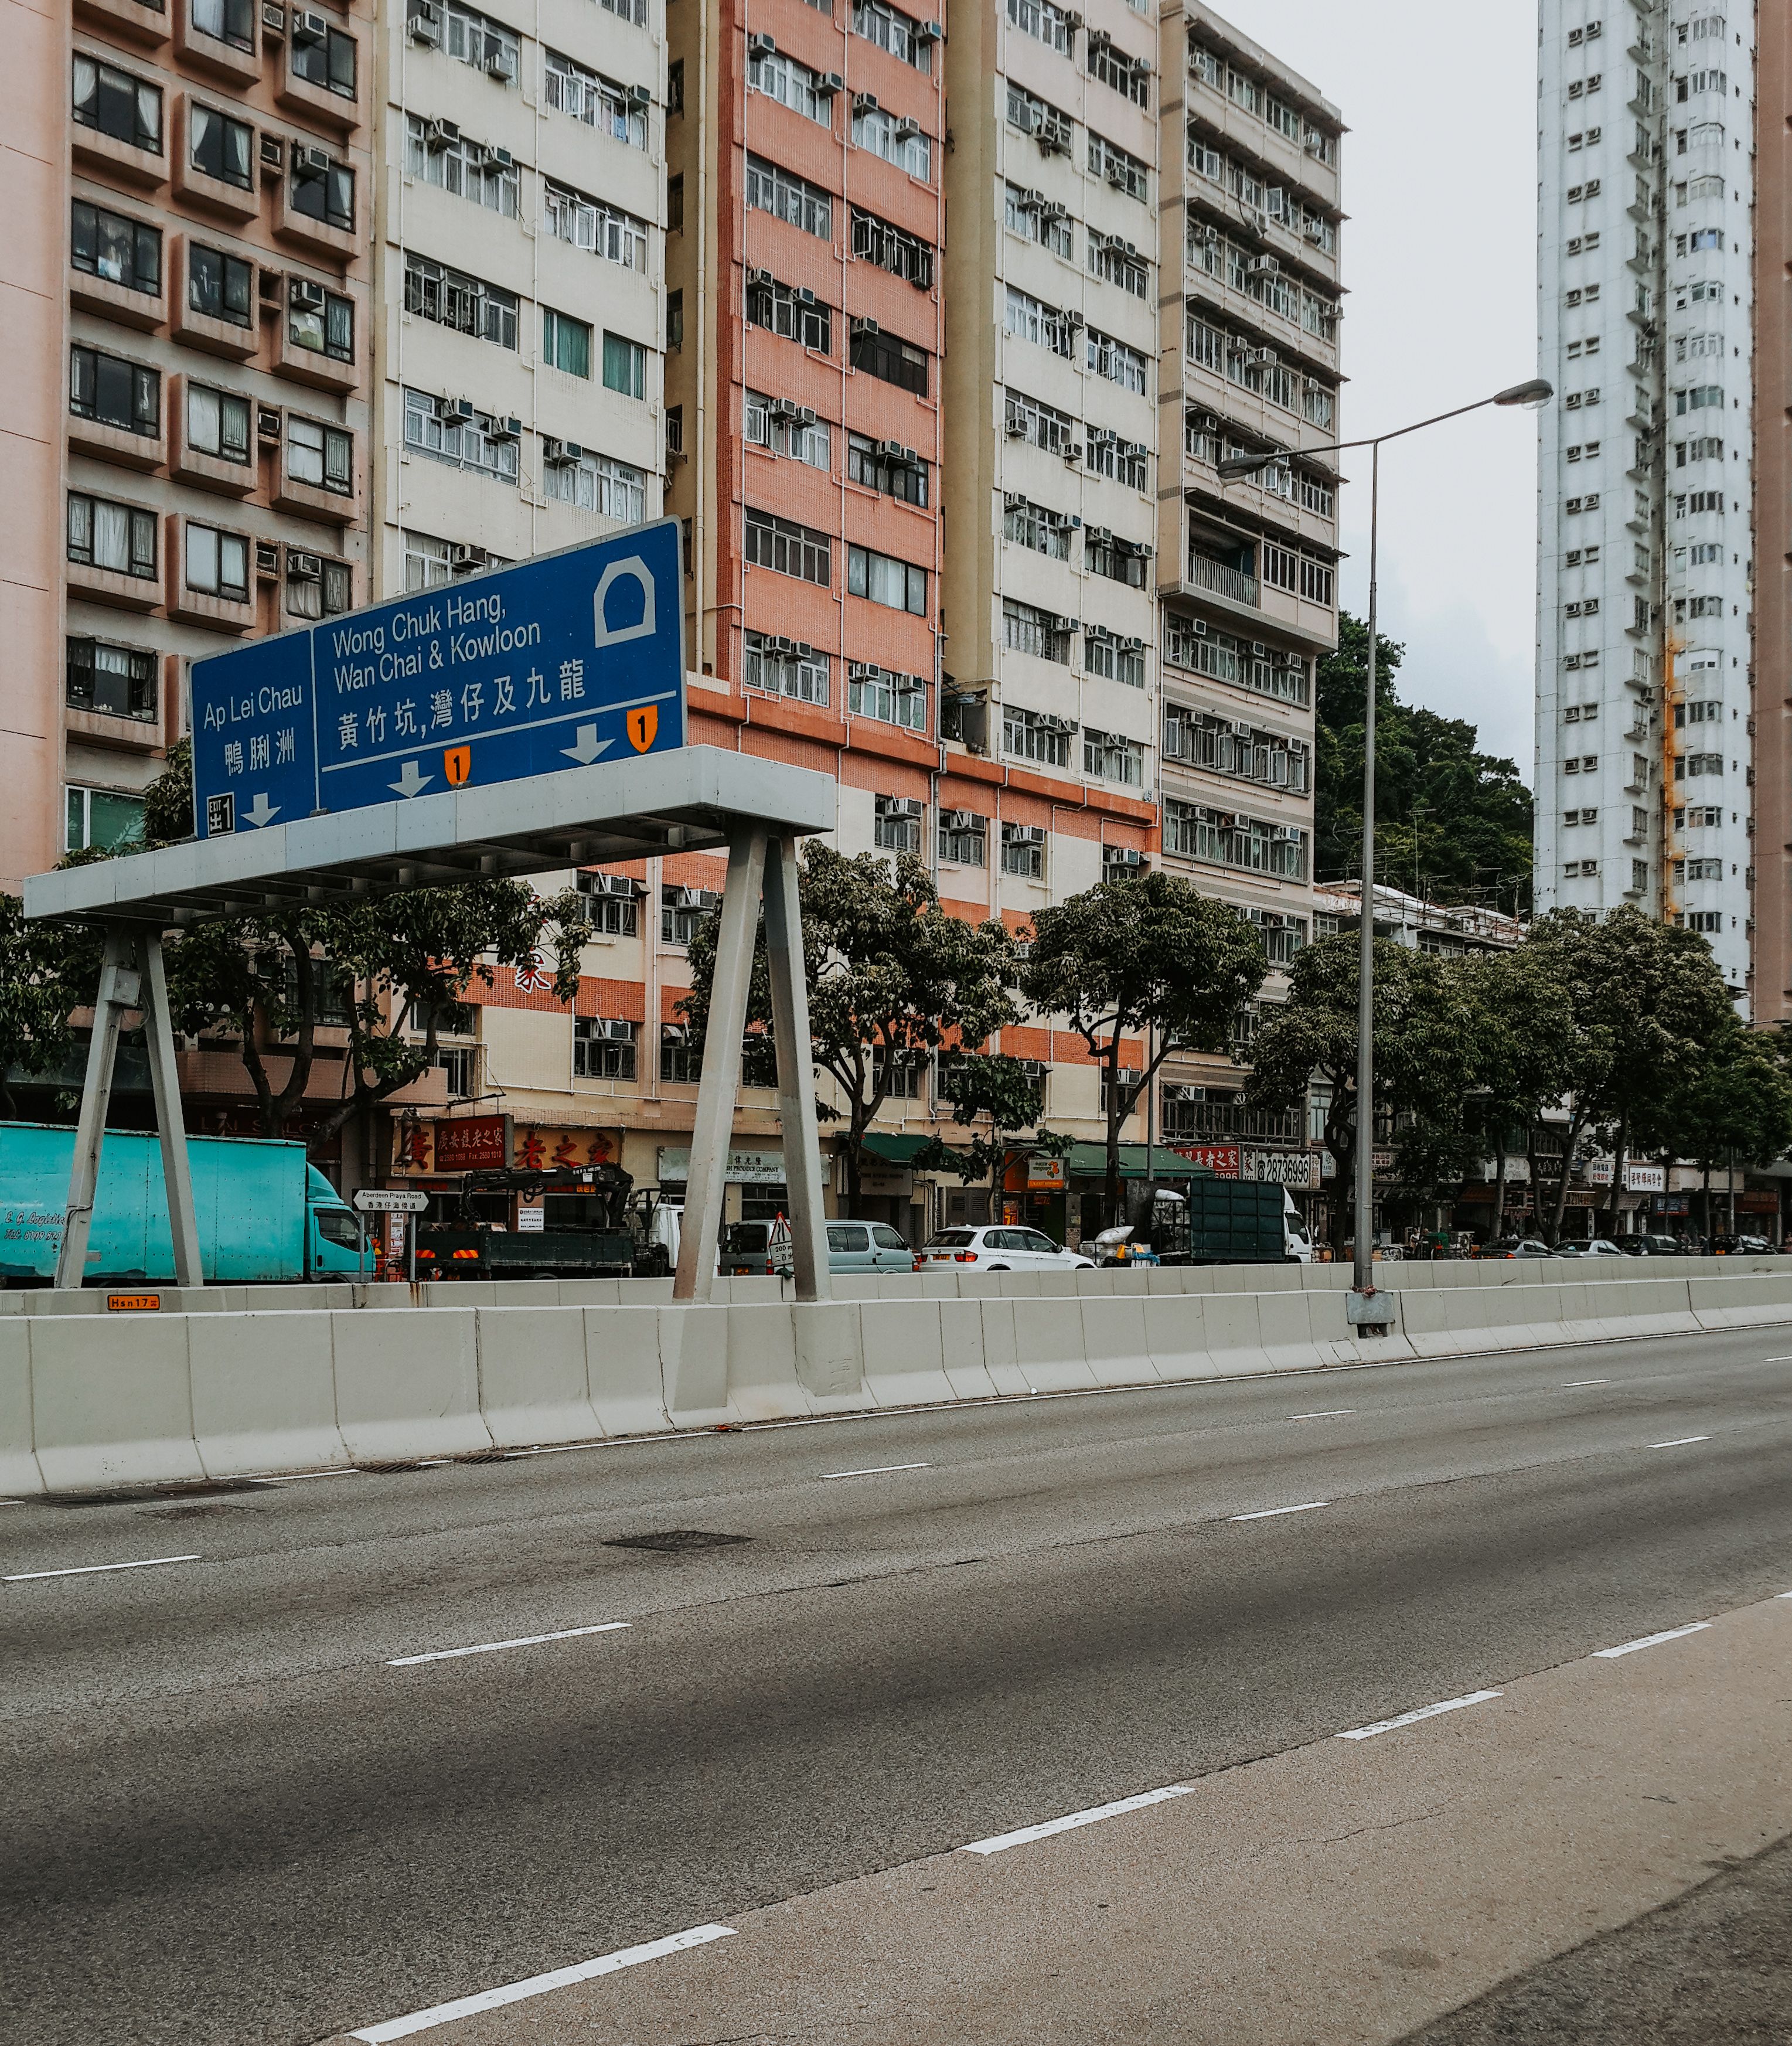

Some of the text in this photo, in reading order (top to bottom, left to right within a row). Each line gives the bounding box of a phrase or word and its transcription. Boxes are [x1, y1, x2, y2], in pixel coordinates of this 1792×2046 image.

[333, 594, 506, 659] Wong Chuk Hang,
[333, 622, 541, 694] Wan Chai & Kowloon
[203, 685, 302, 732] Ap Lei Chau
[637, 715, 646, 743] 1
[224, 727, 295, 777] 鴨脷洲
[453, 754, 461, 781] 1
[209, 799, 222, 813] EXIT
[223, 798, 231, 829] 1
[210, 813, 222, 832] 出
[1266, 1158, 1309, 1183] 28736996
